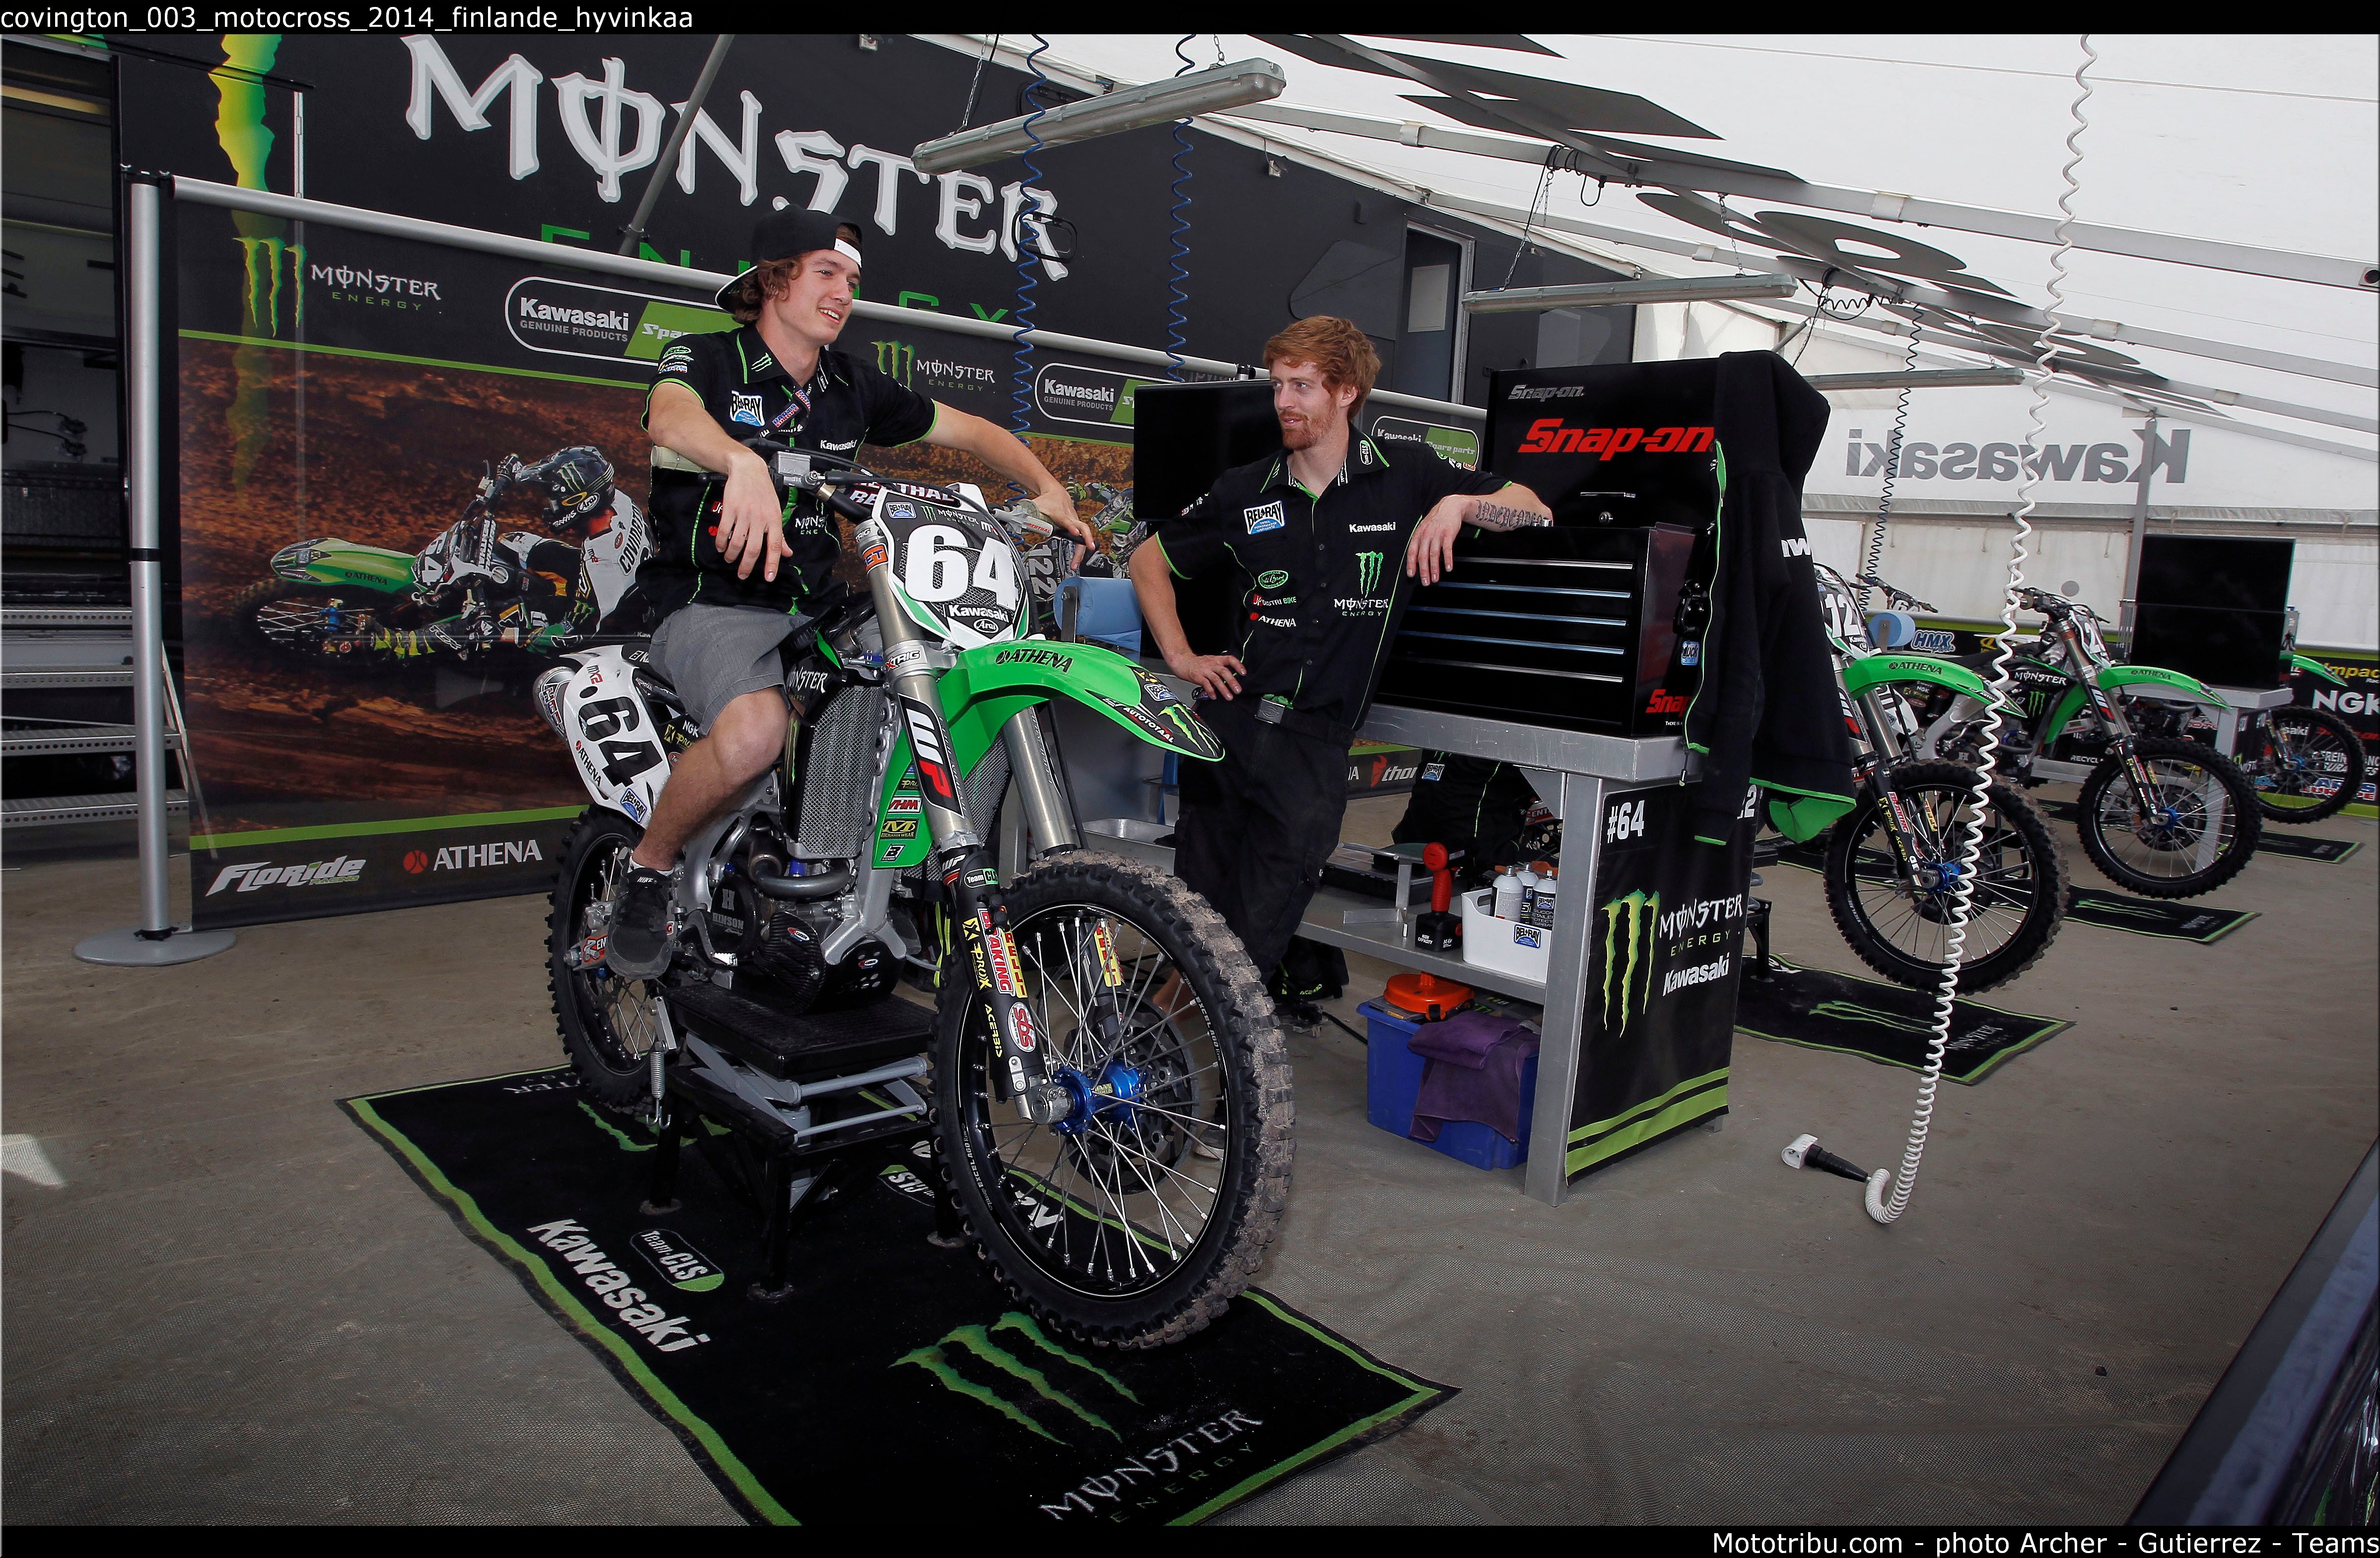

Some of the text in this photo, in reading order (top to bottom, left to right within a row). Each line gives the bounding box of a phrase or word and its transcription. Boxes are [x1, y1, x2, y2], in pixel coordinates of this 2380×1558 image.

[399, 34, 1069, 282] MONSTER
[311, 264, 441, 300] MONSTER
[332, 291, 422, 310] ENERGY
[519, 298, 630, 331] Kawasaki
[519, 320, 629, 343] GENUINE PRODUCTS
[916, 359, 995, 383] MONSTER
[929, 379, 983, 392] ENERGY
[1044, 378, 1115, 403] Kawasaki
[1508, 384, 1584, 402] Snap-on
[1044, 396, 1074, 406] GENUINE
[1076, 400, 1114, 411] PRODUCTS
[820, 439, 857, 451] Kawasaki
[1453, 446, 1475, 455] parts
[1518, 418, 1715, 461] Snap-on
[937, 509, 979, 524] MONSTER
[1348, 522, 1396, 533] Kawasaki
[351, 572, 388, 585] ATHENA
[904, 524, 1019, 610] 64
[949, 605, 1009, 623] Kawasaki
[1334, 597, 1389, 612] MONSTER
[1258, 615, 1296, 627] ATHENA
[1913, 631, 1953, 648] HMX
[885, 650, 920, 669] XTRIG
[1008, 648, 1073, 673] ATHENA
[1897, 661, 1942, 675] ATHENA
[2014, 670, 2068, 686] MONSTER
[2136, 670, 2171, 680] ATHENA
[2311, 689, 2380, 715] NGK
[1122, 707, 1175, 743] AUTOTOTAAL
[578, 696, 664, 787] 64
[578, 745, 602, 786] ATHENA
[1607, 799, 1645, 844] #64
[433, 839, 543, 872] ATHENA
[308, 875, 360, 885] RACING
[966, 874, 984, 884] Team
[712, 912, 744, 930] HINSON
[1660, 893, 1743, 940] MONSTER
[1670, 929, 1731, 957] ENERGY
[1662, 952, 1731, 997] Kawasaki
[970, 1159, 984, 1188] EXCEL
[641, 1230, 709, 1280] Team CLS
[527, 1219, 710, 1352] Kawasaki
[1038, 1410, 1263, 1521] MONSTER
[1109, 1444, 1256, 1524] ENERGY
